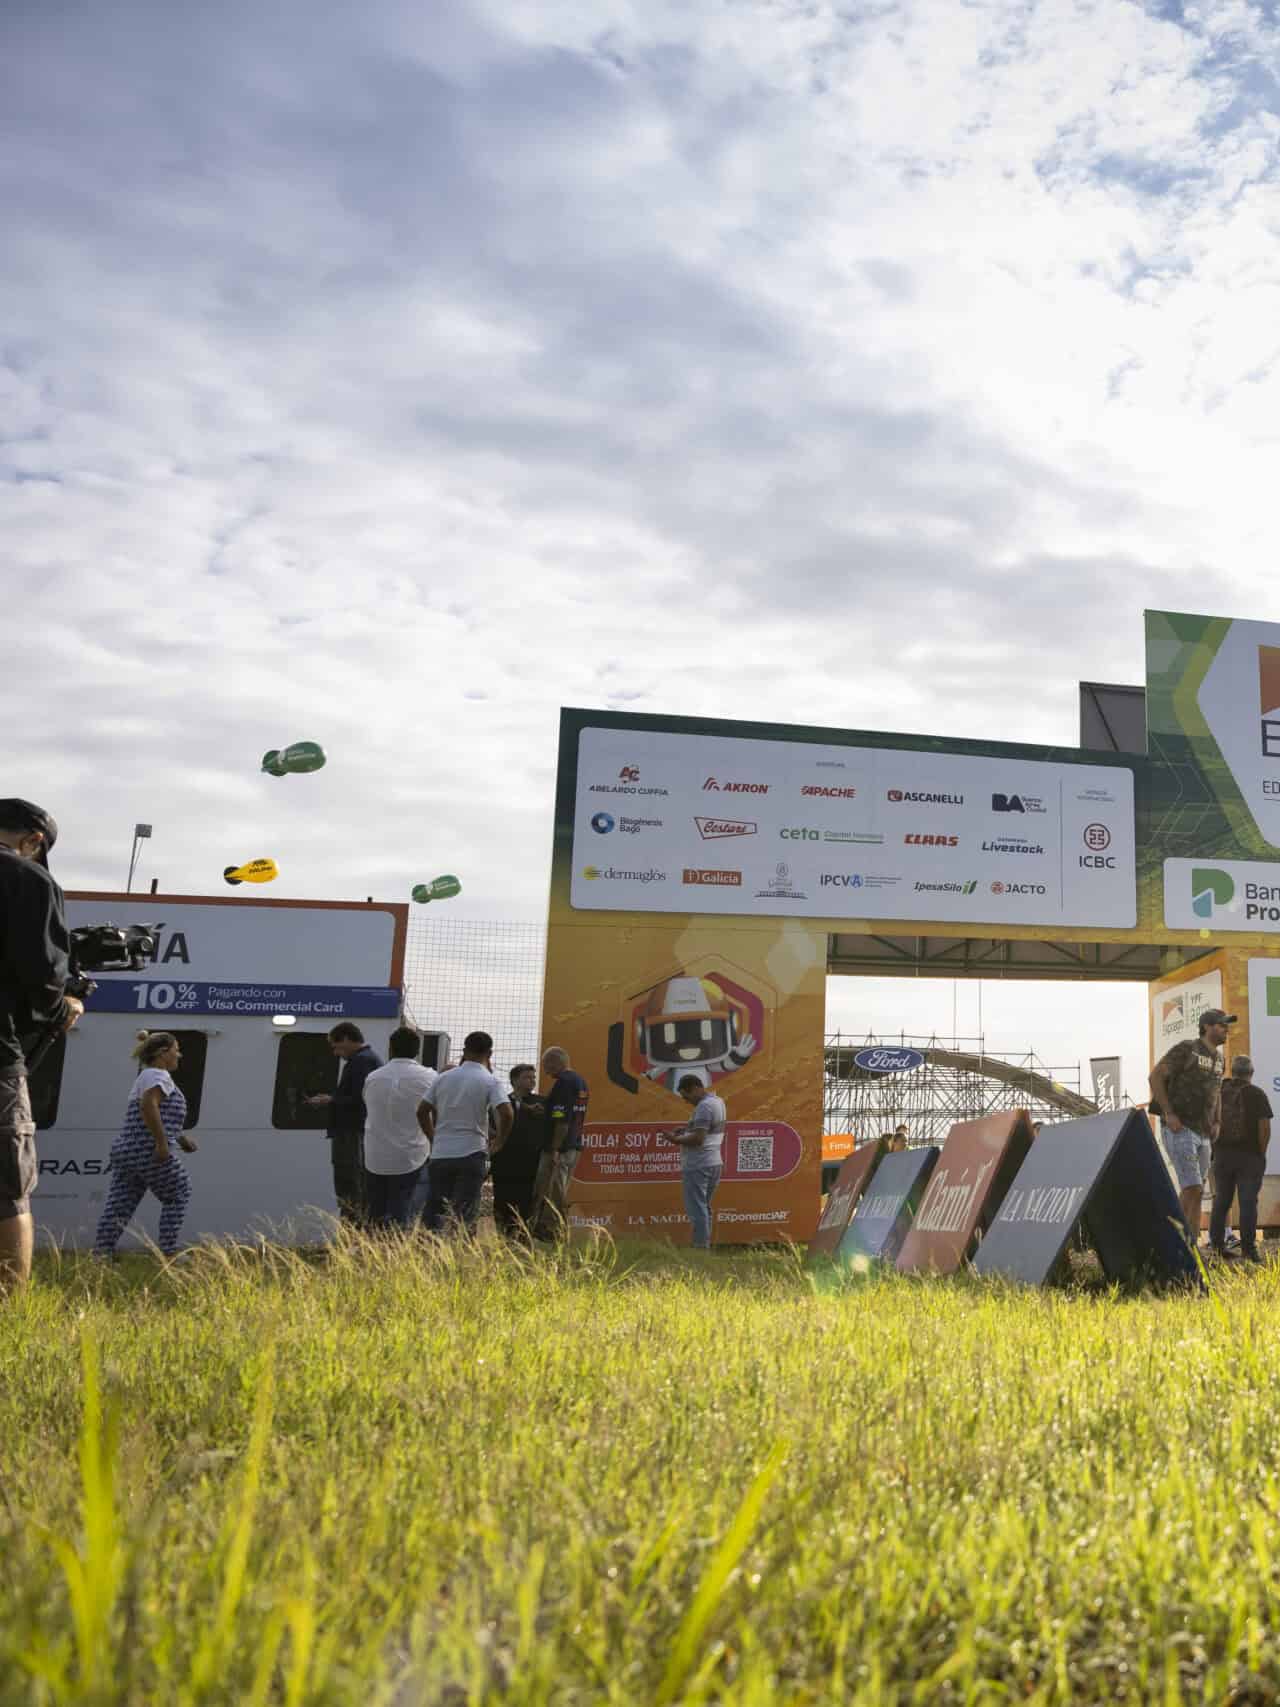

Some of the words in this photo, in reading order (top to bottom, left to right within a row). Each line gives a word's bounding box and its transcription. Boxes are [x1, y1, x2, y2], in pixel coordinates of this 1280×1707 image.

[723, 783, 768, 794] AKRON
[801, 785, 856, 798] APACHE
[904, 791, 963, 804] ASCANELLI
[992, 793, 1025, 813] BA
[780, 826, 819, 840] ceta
[904, 833, 960, 847] CLAAS
[981, 841, 1044, 854] Livestock
[1079, 855, 1116, 869] ICBC
[604, 867, 666, 884] dermaglós
[702, 874, 740, 884] Galicia
[1005, 883, 1046, 894] JACTO
[208, 986, 262, 999] Pagando
[263, 989, 286, 998] con
[207, 1000, 236, 1010] Visa
[236, 1001, 312, 1012] Commercial
[868, 1049, 910, 1069] Ford
[624, 1132, 651, 1147] SOY
